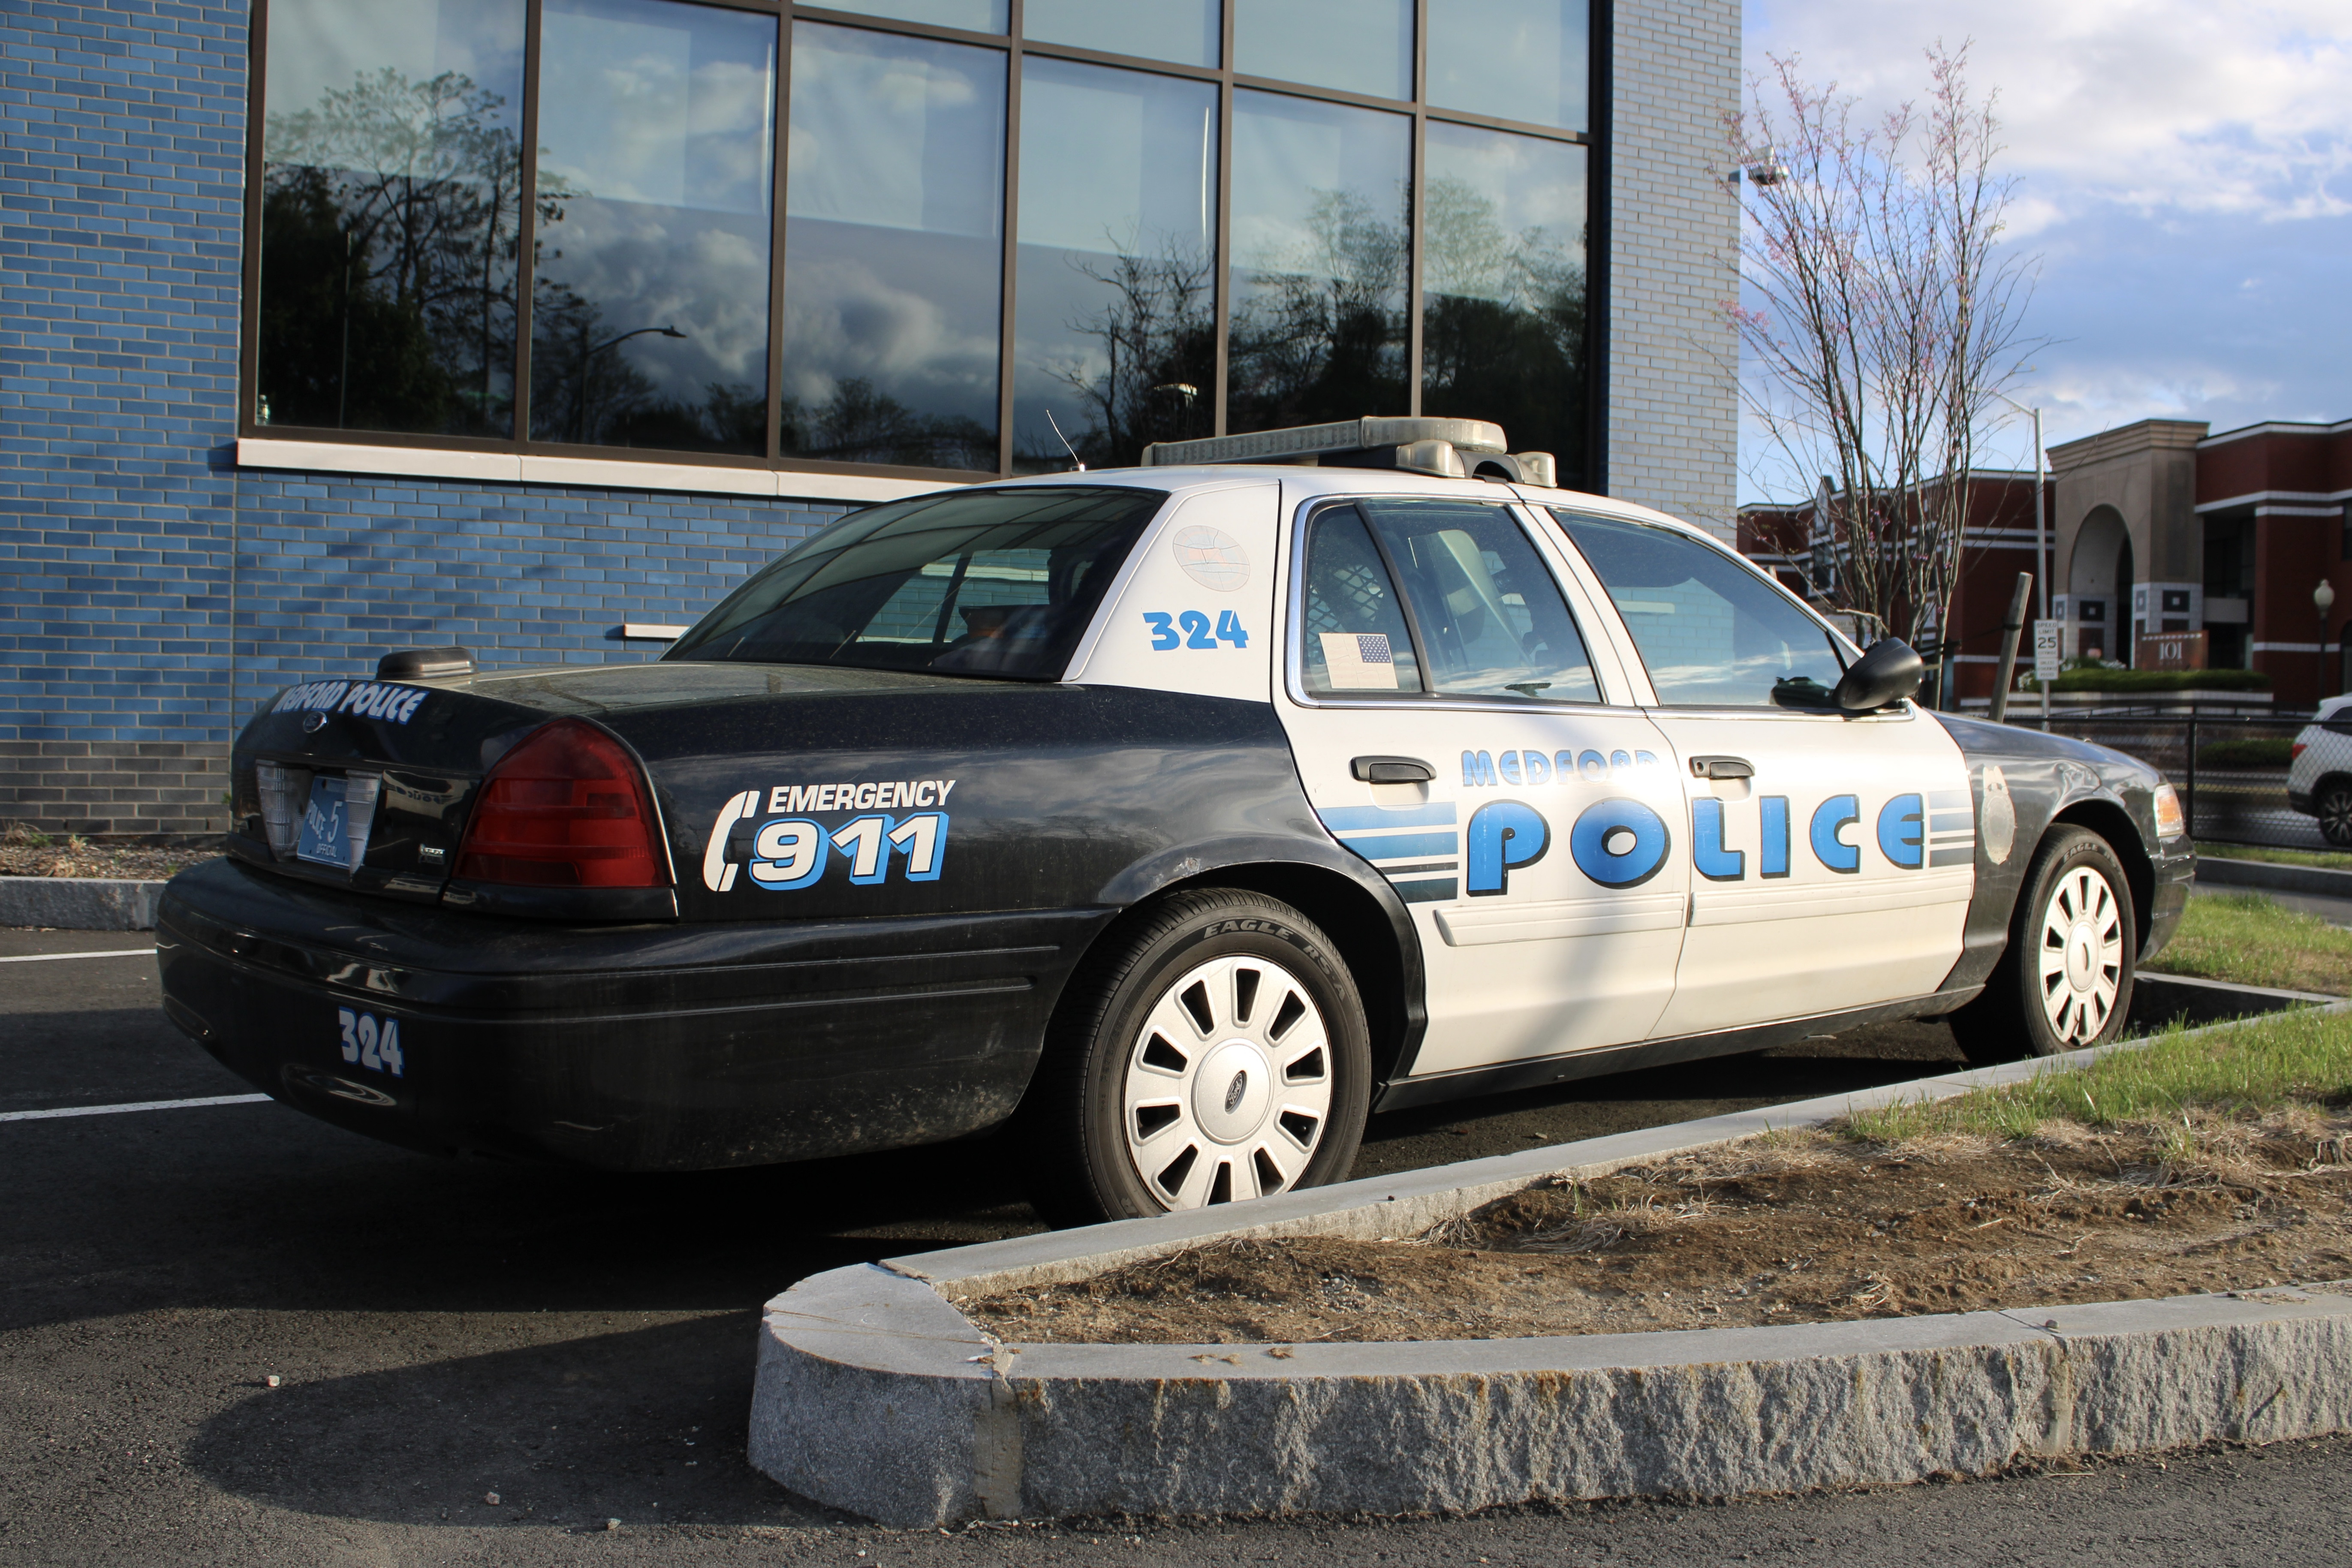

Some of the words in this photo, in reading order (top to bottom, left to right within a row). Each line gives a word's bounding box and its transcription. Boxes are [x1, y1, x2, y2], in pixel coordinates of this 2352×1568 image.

[1143, 610, 1249, 651] 324
[2038, 637, 2057, 648] 25
[2159, 642, 2182, 660] 101
[337, 681, 429, 725] POLICE
[767, 780, 956, 814] EMERGENCY
[306, 799, 326, 840] POLICE
[327, 801, 343, 843] 5
[316, 843, 337, 857] OFFICIAL
[749, 812, 949, 891] 911
[1466, 793, 1924, 897] POLICE
[2063, 843, 2098, 863] EAGLE
[1203, 919, 1294, 940] EAGLE
[1303, 945, 1346, 1002] RS-A
[338, 1006, 405, 1078] 324
[1228, 1080, 1241, 1105] Ford
